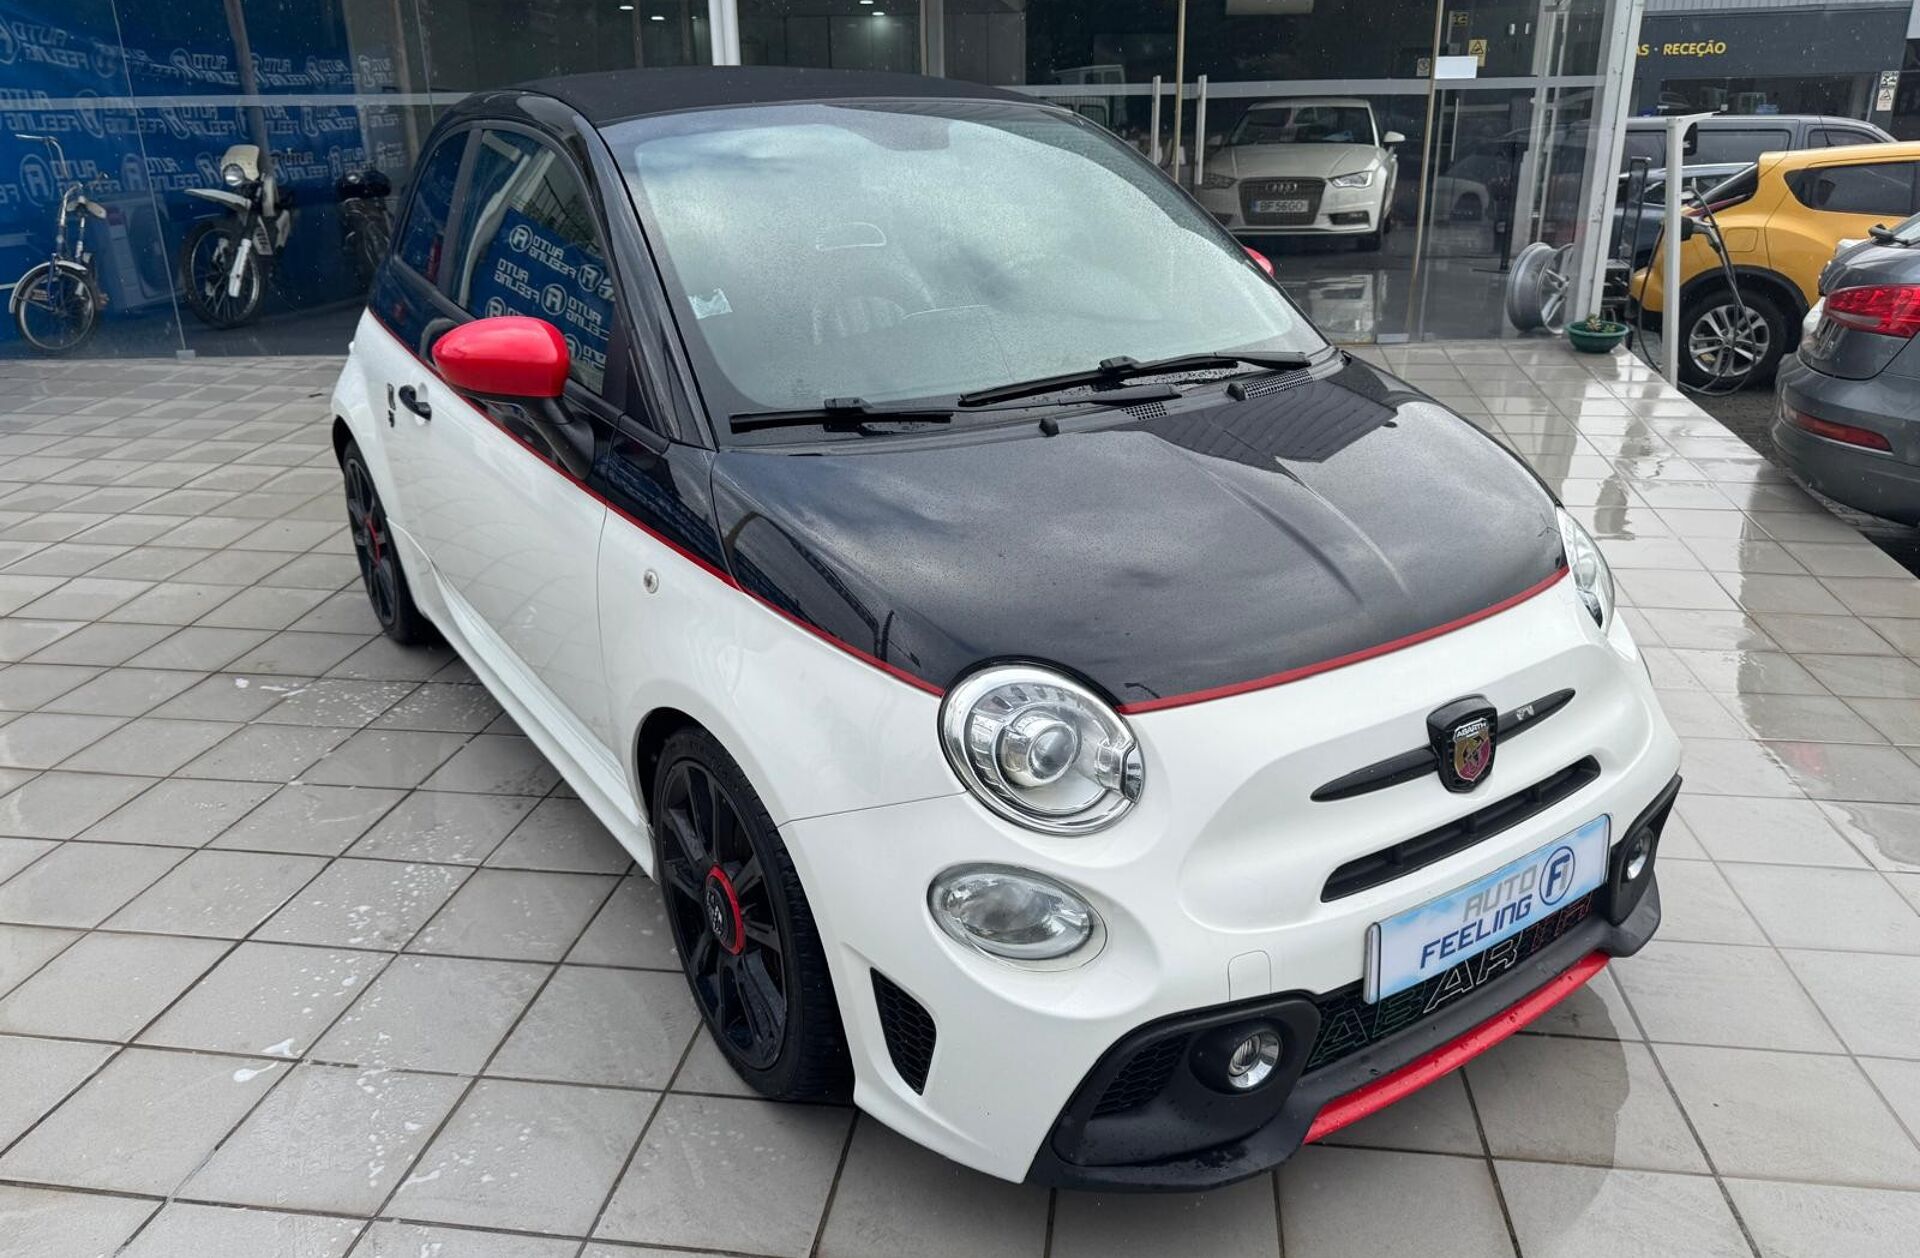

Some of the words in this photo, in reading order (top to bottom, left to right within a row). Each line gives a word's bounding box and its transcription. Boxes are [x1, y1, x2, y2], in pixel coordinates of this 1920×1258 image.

[1663, 40, 1727, 58] RECEÇÃO
[1456, 722, 1487, 738] ABARTH
[1463, 864, 1538, 922] AUTO
[1420, 894, 1533, 969] FEELING
